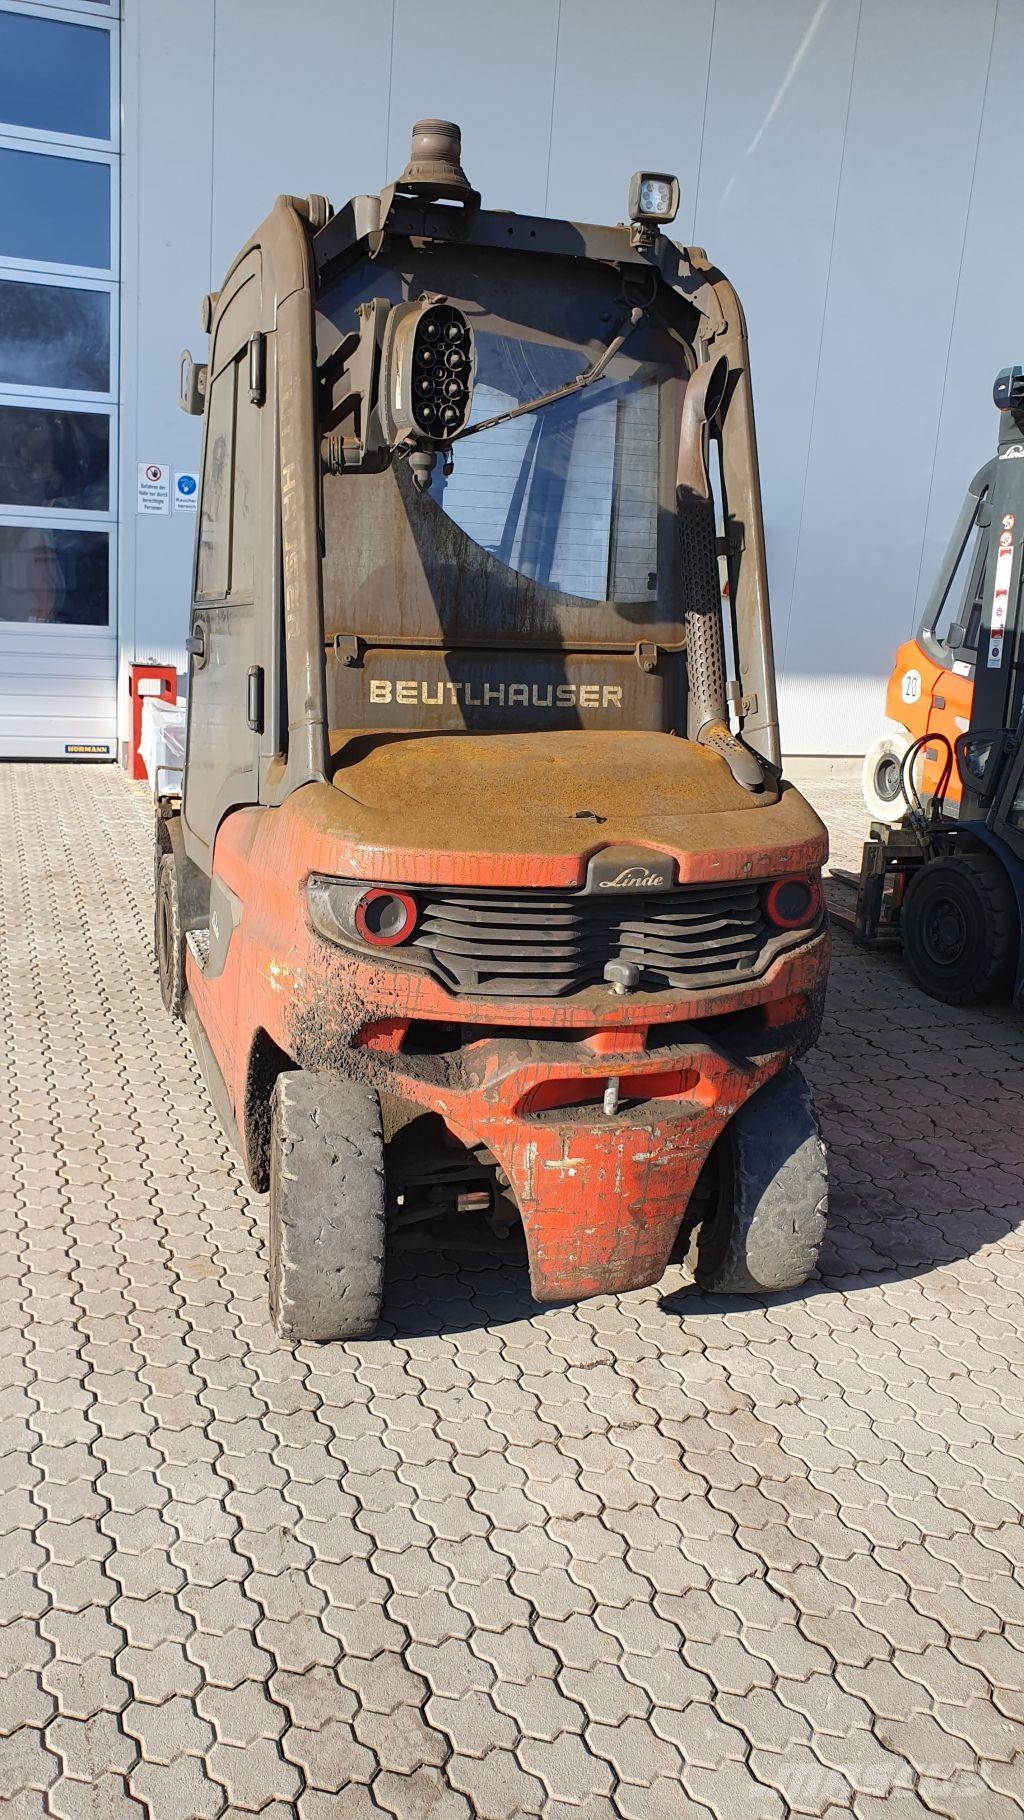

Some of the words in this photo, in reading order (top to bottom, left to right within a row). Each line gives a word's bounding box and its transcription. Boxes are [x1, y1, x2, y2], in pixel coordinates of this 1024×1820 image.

[999, 445, 1024, 459] Lind
[369, 679, 624, 708] BEUTLHAUSER
[905, 676, 918, 697] 20
[599, 867, 664, 888] Linde
